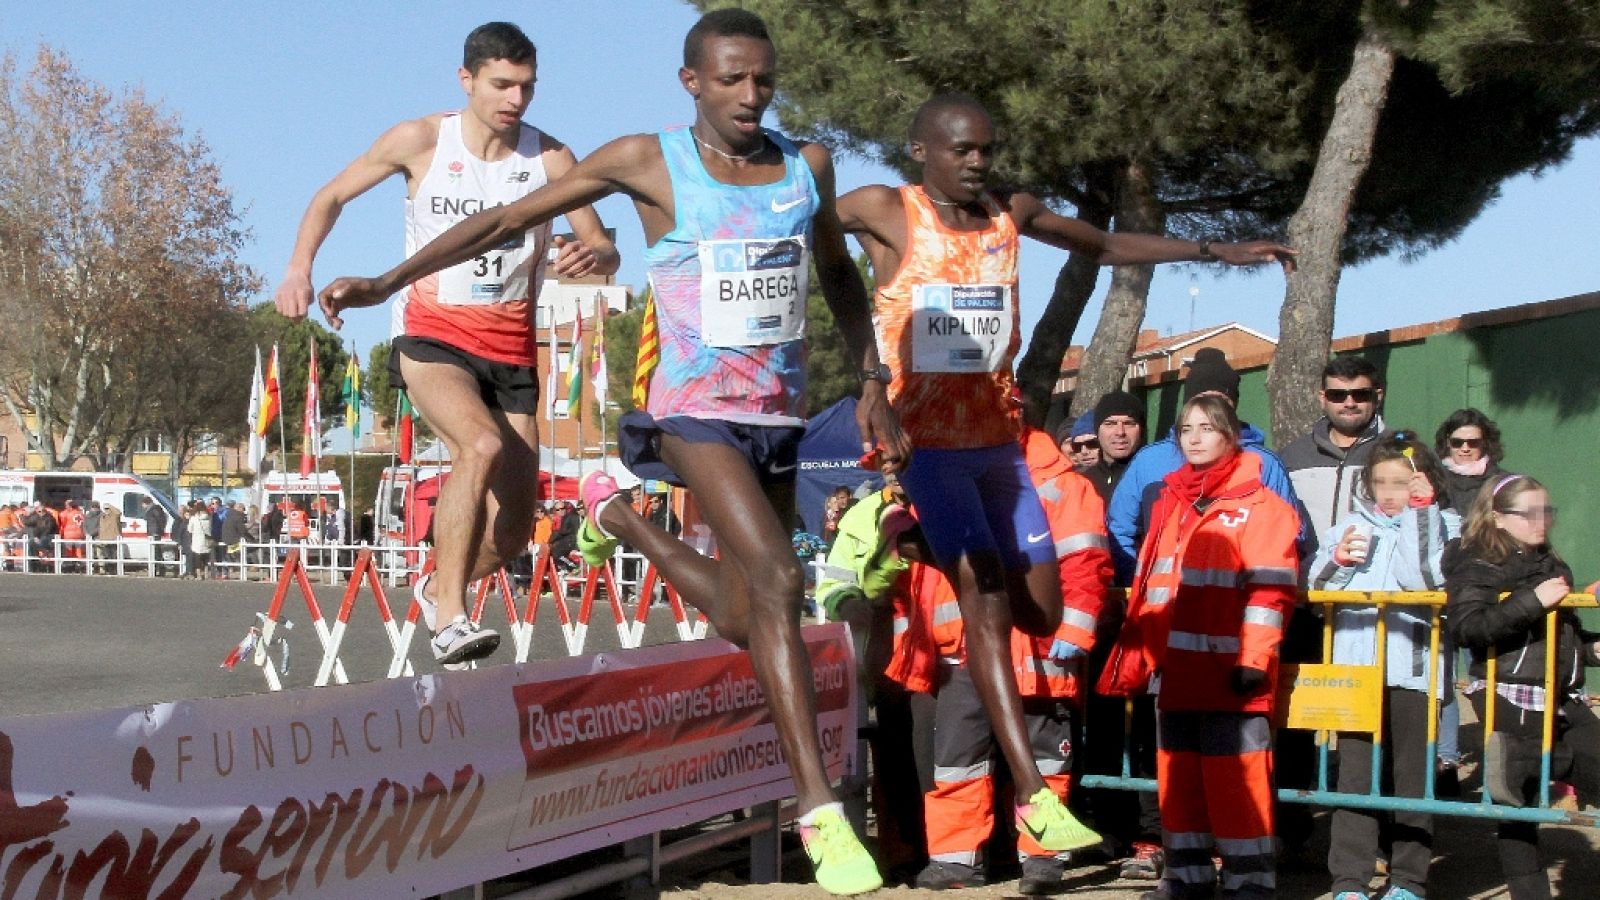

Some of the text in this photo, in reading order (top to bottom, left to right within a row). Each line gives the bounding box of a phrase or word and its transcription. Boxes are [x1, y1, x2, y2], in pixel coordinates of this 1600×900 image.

[430, 196, 506, 216] ENGL
[473, 256, 503, 277] 31
[719, 274, 799, 302] BAREGA
[788, 300, 795, 315] 2
[928, 316, 1001, 336] KIPLIMO
[990, 338, 995, 351] 1
[527, 699, 643, 751] Buscamos
[639, 685, 712, 738] jóvenes
